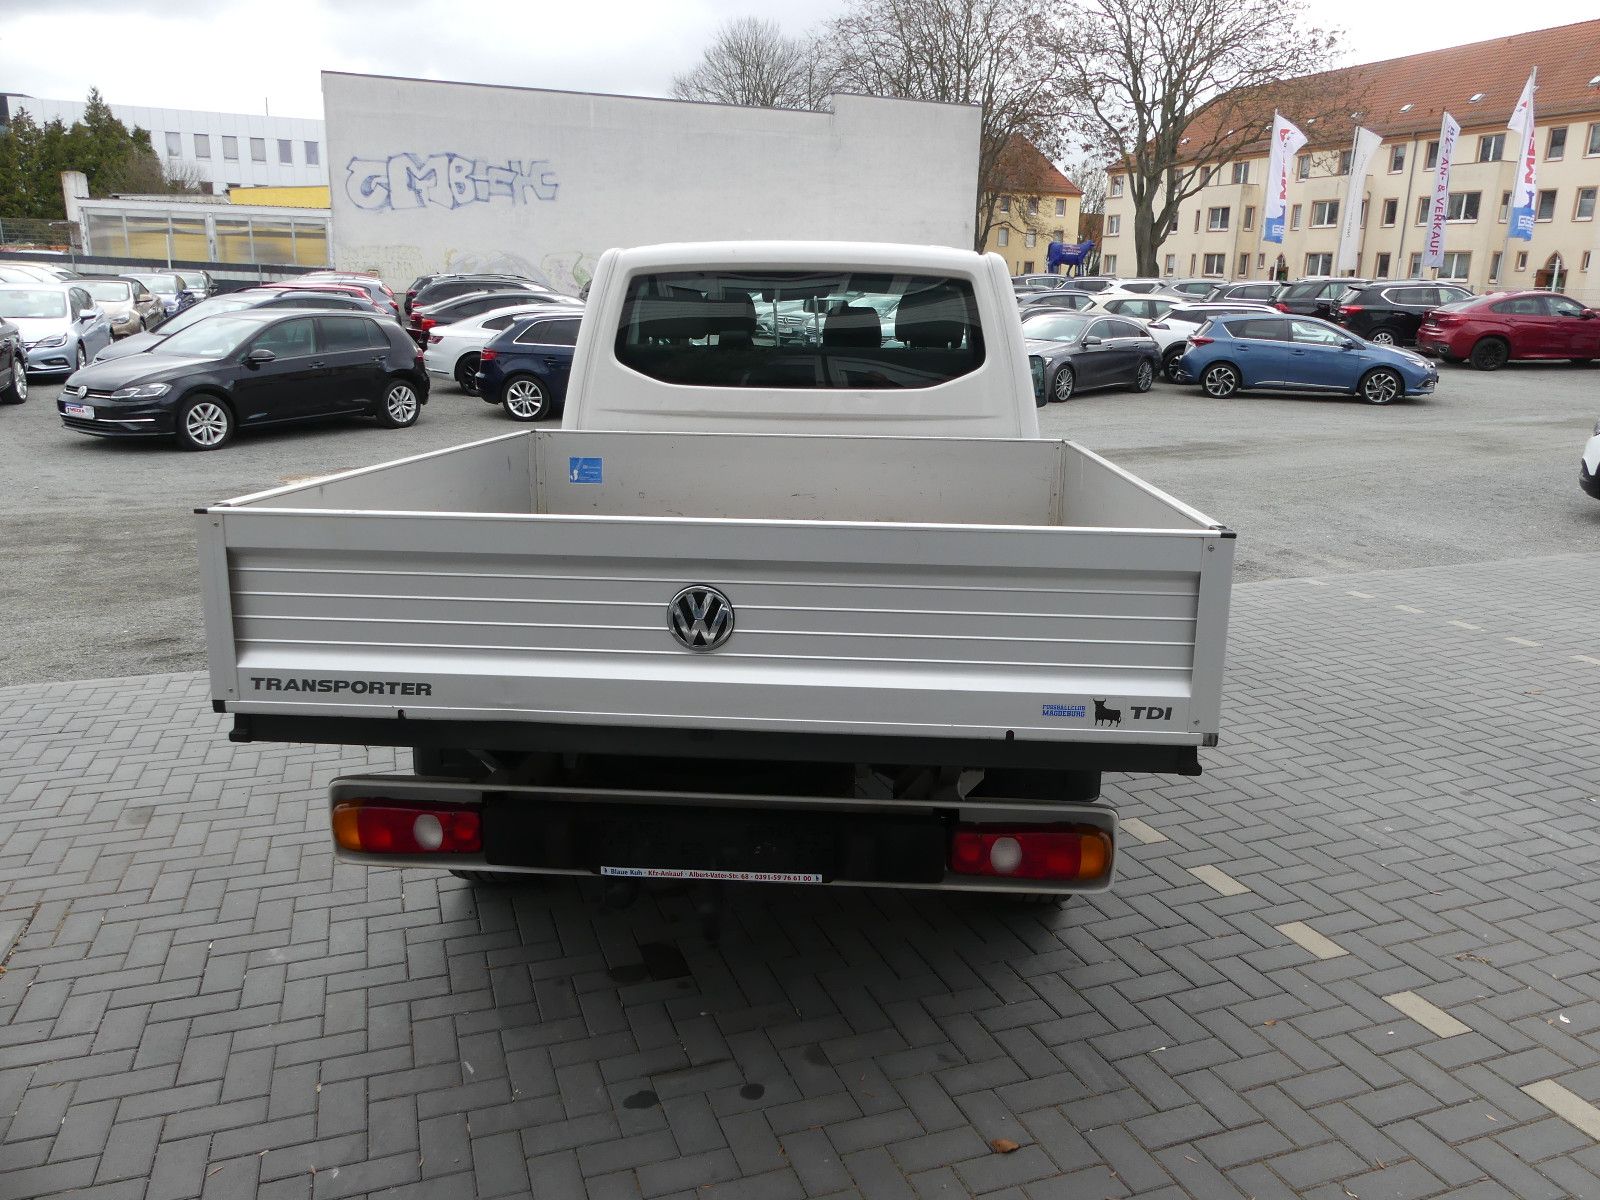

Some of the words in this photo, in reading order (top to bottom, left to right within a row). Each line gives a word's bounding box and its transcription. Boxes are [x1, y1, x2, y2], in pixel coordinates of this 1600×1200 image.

[1437, 184, 1446, 193] &
[1429, 197, 1445, 256] VERKAUF
[667, 584, 734, 652] VW
[250, 677, 432, 696] TRANSPORTER
[1042, 710, 1086, 718] MAGDEBURG
[1131, 706, 1173, 721] TDI
[610, 868, 628, 876] Blaue
